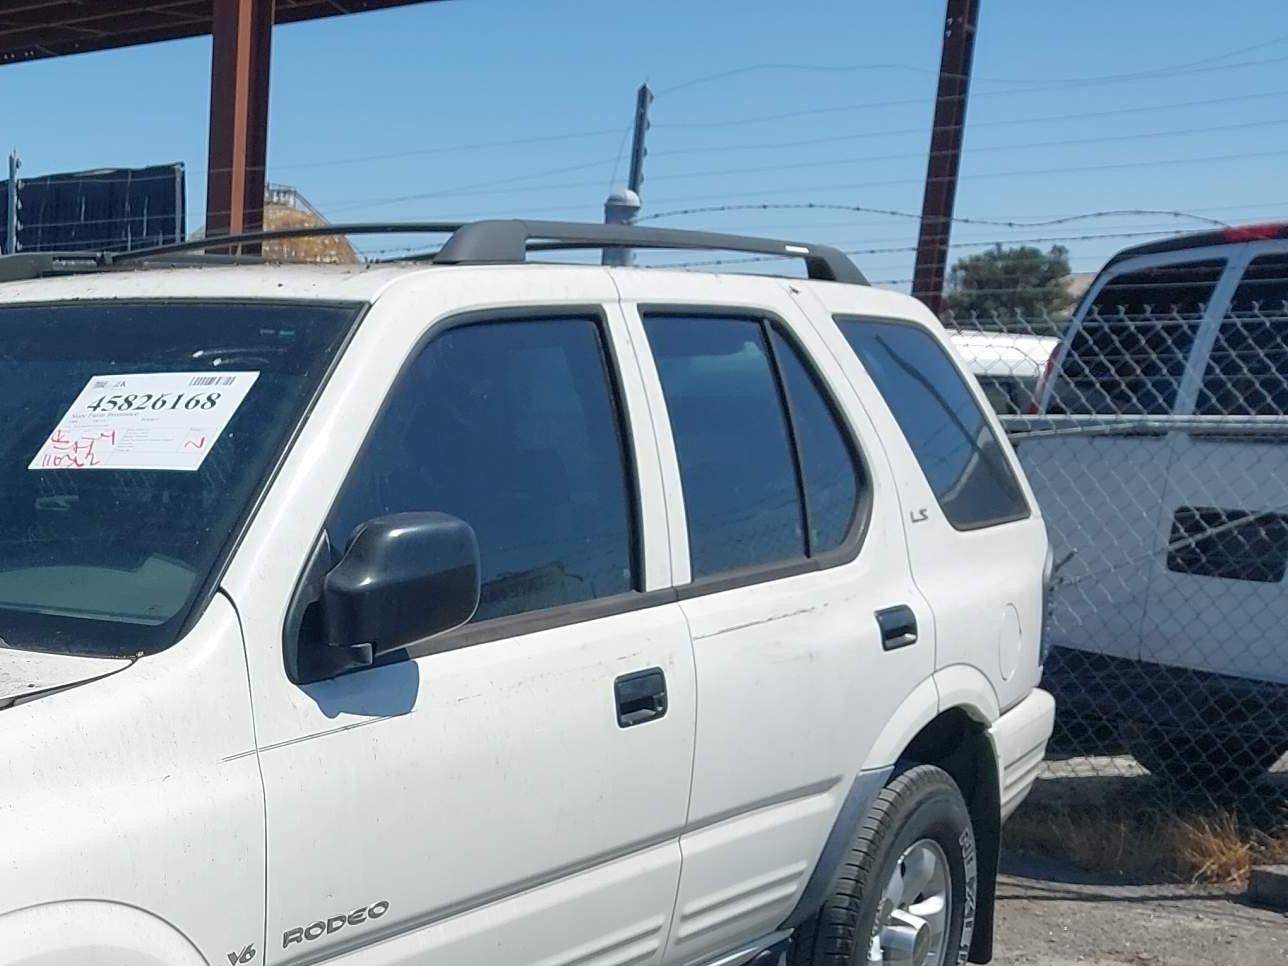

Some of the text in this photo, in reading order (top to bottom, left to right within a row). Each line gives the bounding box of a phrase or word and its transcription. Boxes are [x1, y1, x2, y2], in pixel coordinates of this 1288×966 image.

[87, 392, 222, 412] 45826168
[909, 508, 929, 523] LS
[282, 900, 389, 949] RODEO
[226, 943, 256, 966] V6
